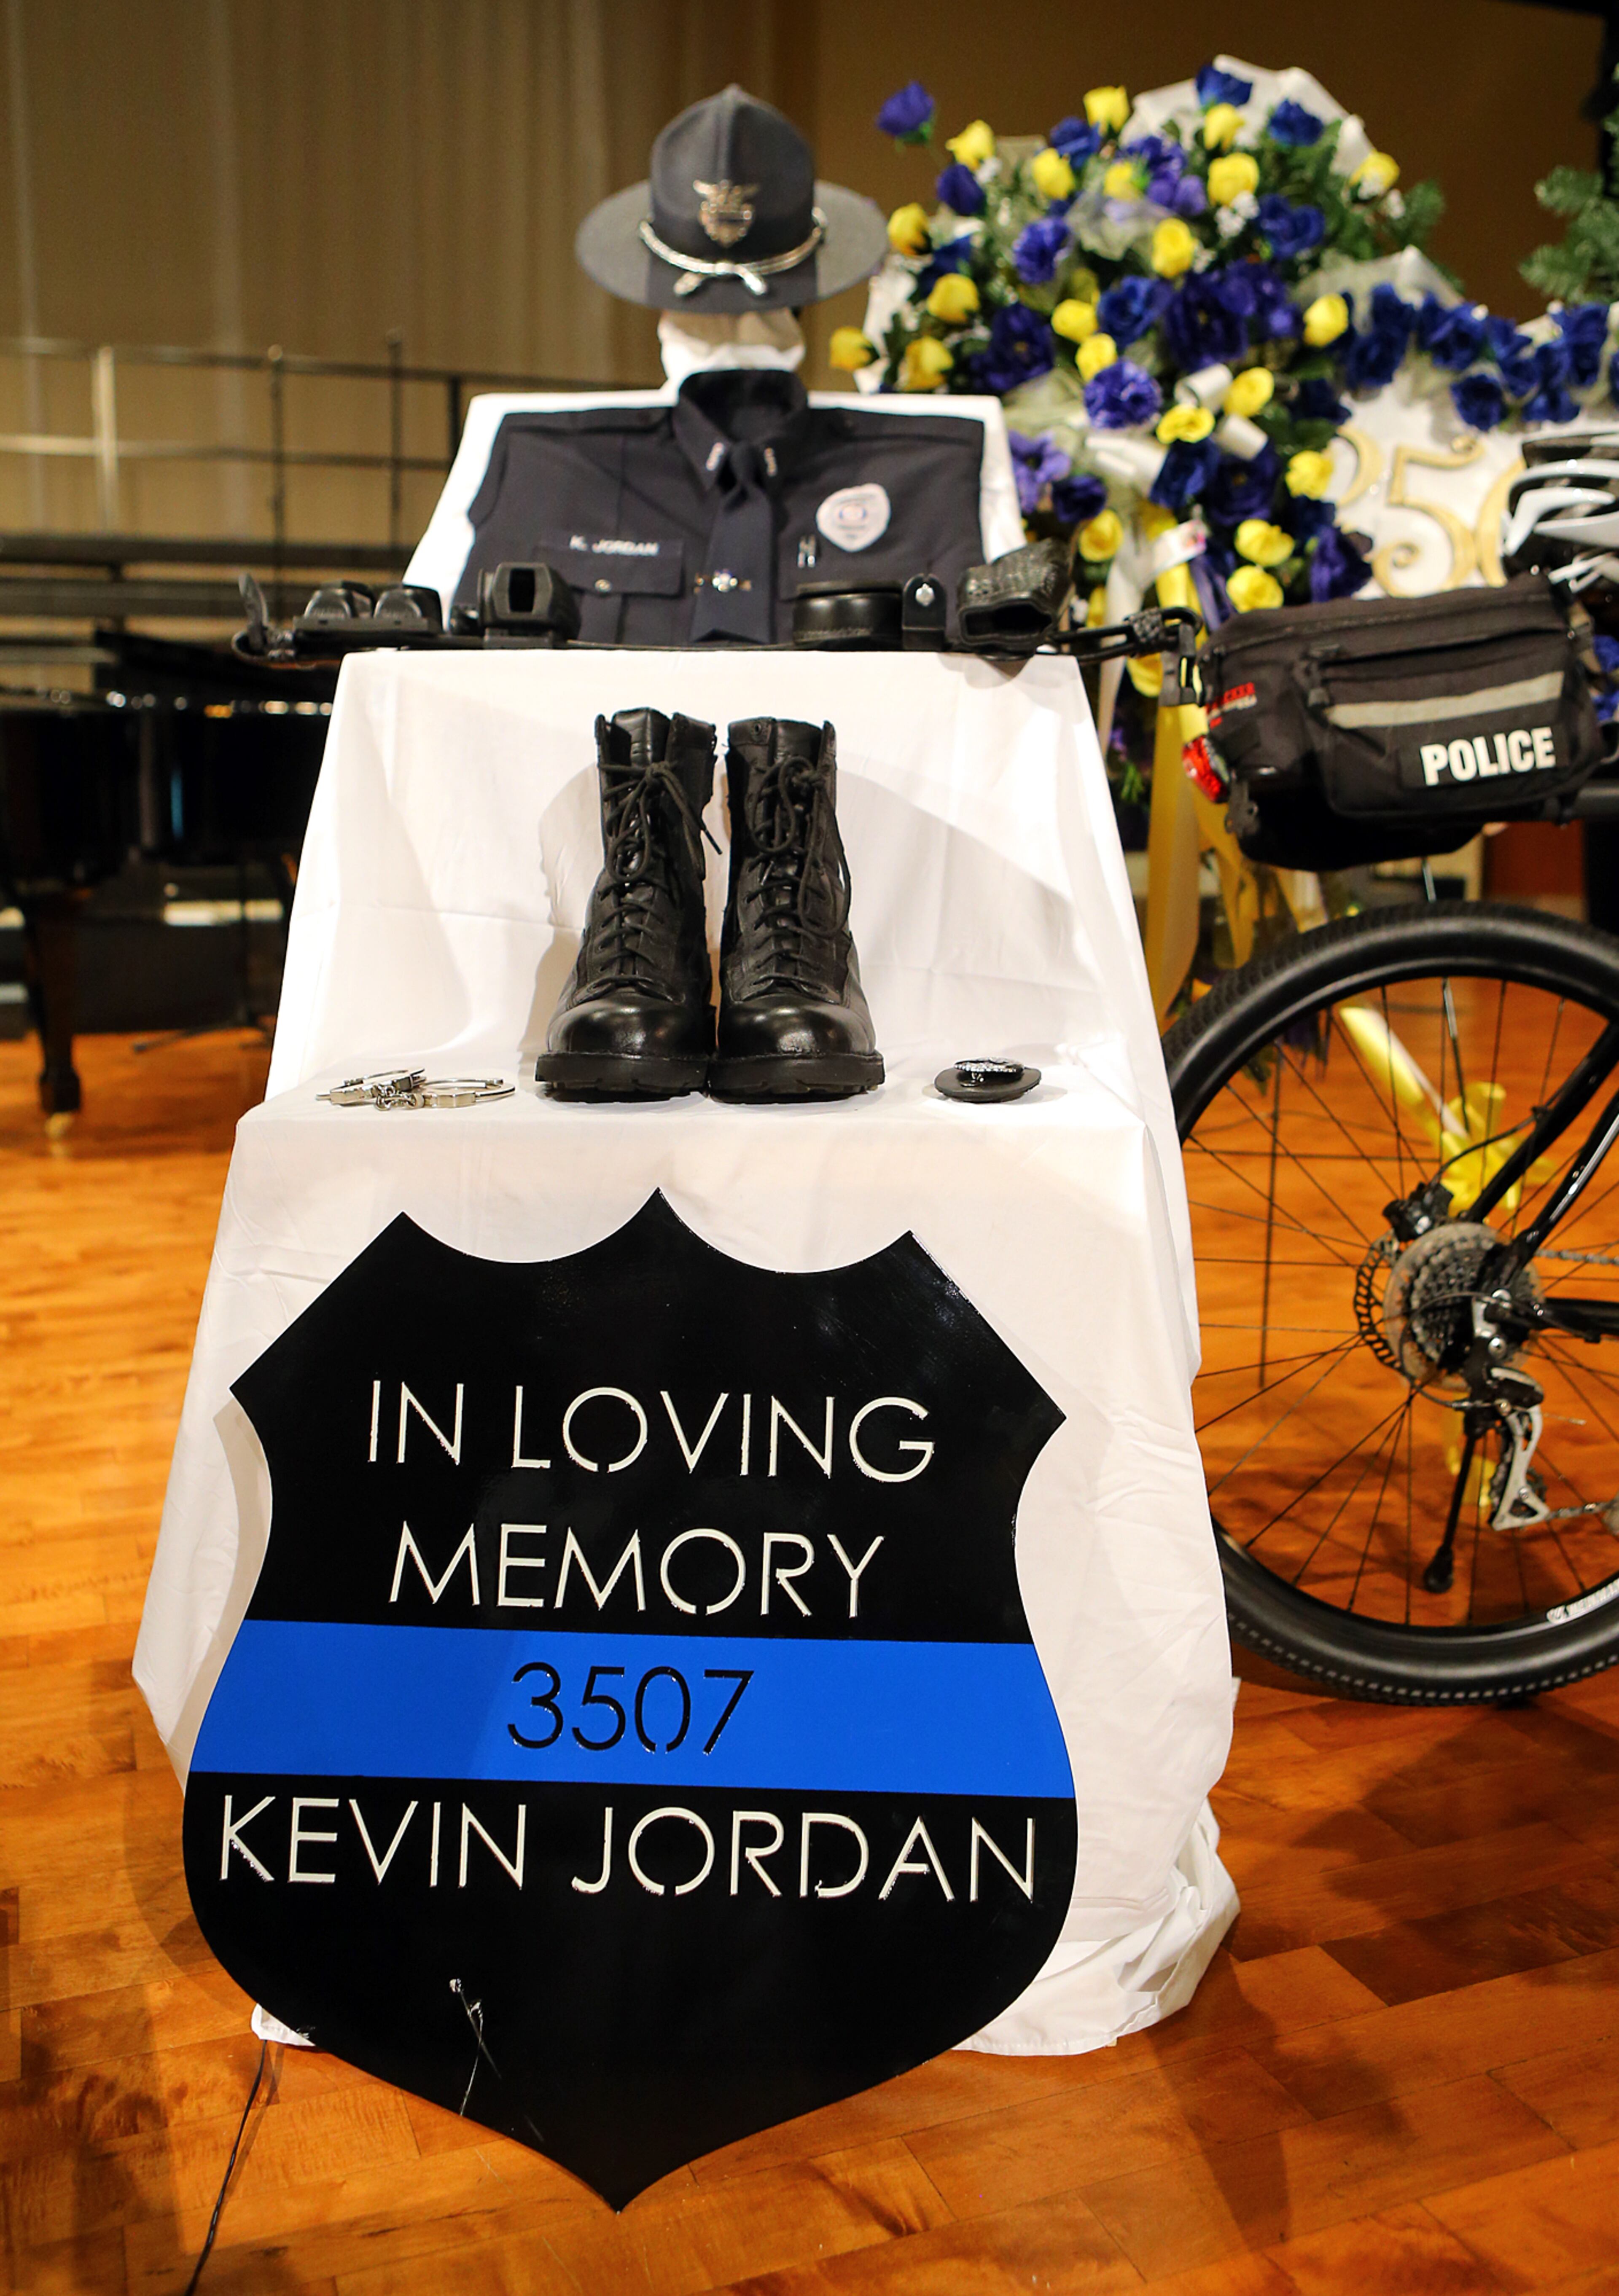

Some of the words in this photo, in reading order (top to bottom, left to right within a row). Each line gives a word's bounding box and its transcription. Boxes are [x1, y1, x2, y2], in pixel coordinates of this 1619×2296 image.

[591, 539, 659, 557] JORDAN
[1420, 726, 1556, 786] POLICE
[368, 1380, 464, 1466] IN
[511, 1385, 935, 1483] LOVING
[389, 1520, 885, 1618] MEMORY
[507, 1661, 755, 1755] 3507
[220, 1794, 527, 1888] KEVIN
[571, 1807, 1034, 1902] JORDAN
